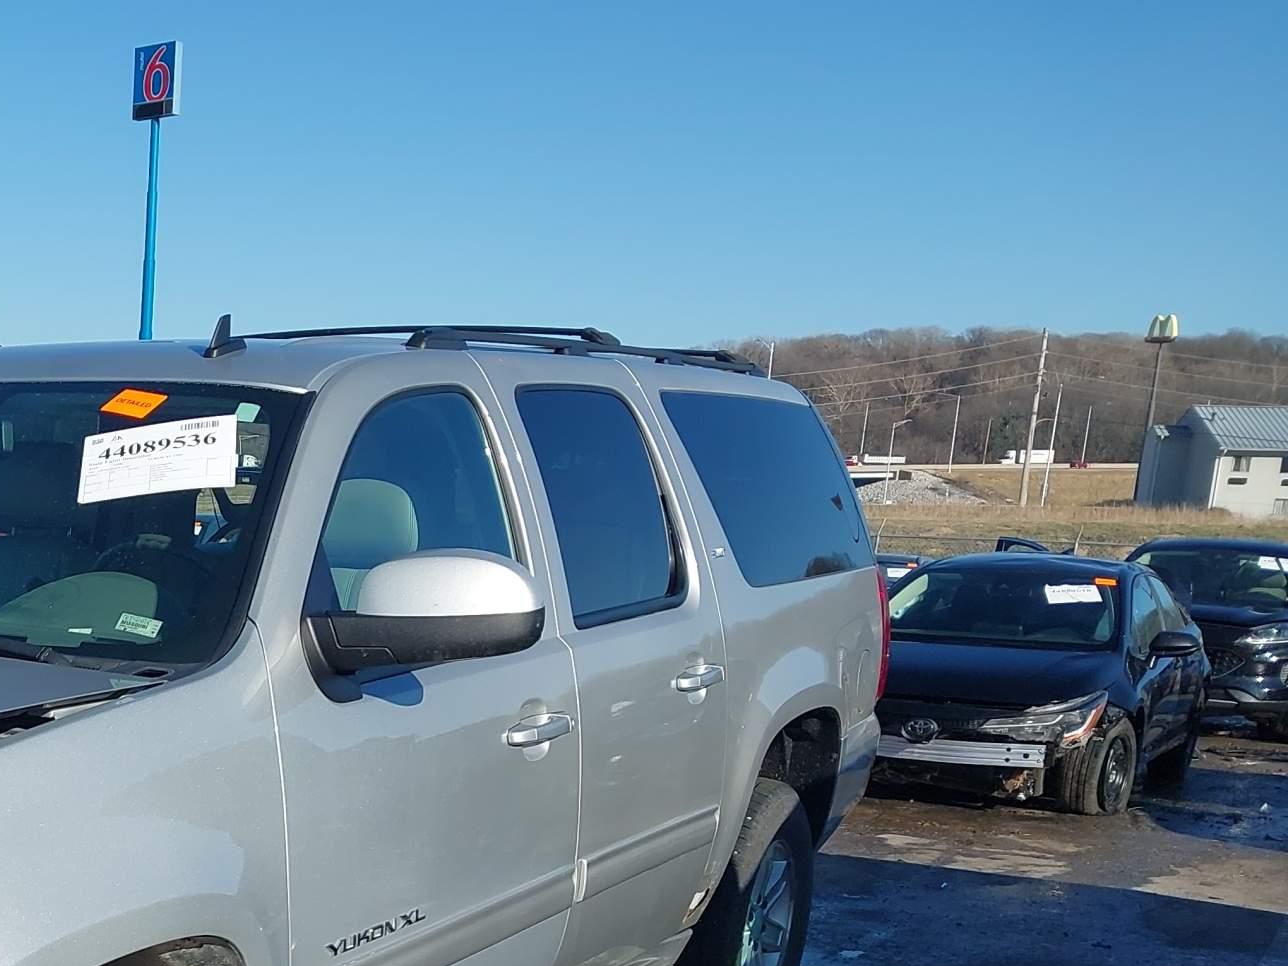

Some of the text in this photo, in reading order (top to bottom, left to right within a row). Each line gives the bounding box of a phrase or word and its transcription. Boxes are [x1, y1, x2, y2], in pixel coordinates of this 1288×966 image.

[143, 45, 171, 102] 6
[115, 397, 152, 408] DETAILED
[98, 432, 217, 460] 44089536
[326, 908, 427, 957] YUKON XL
